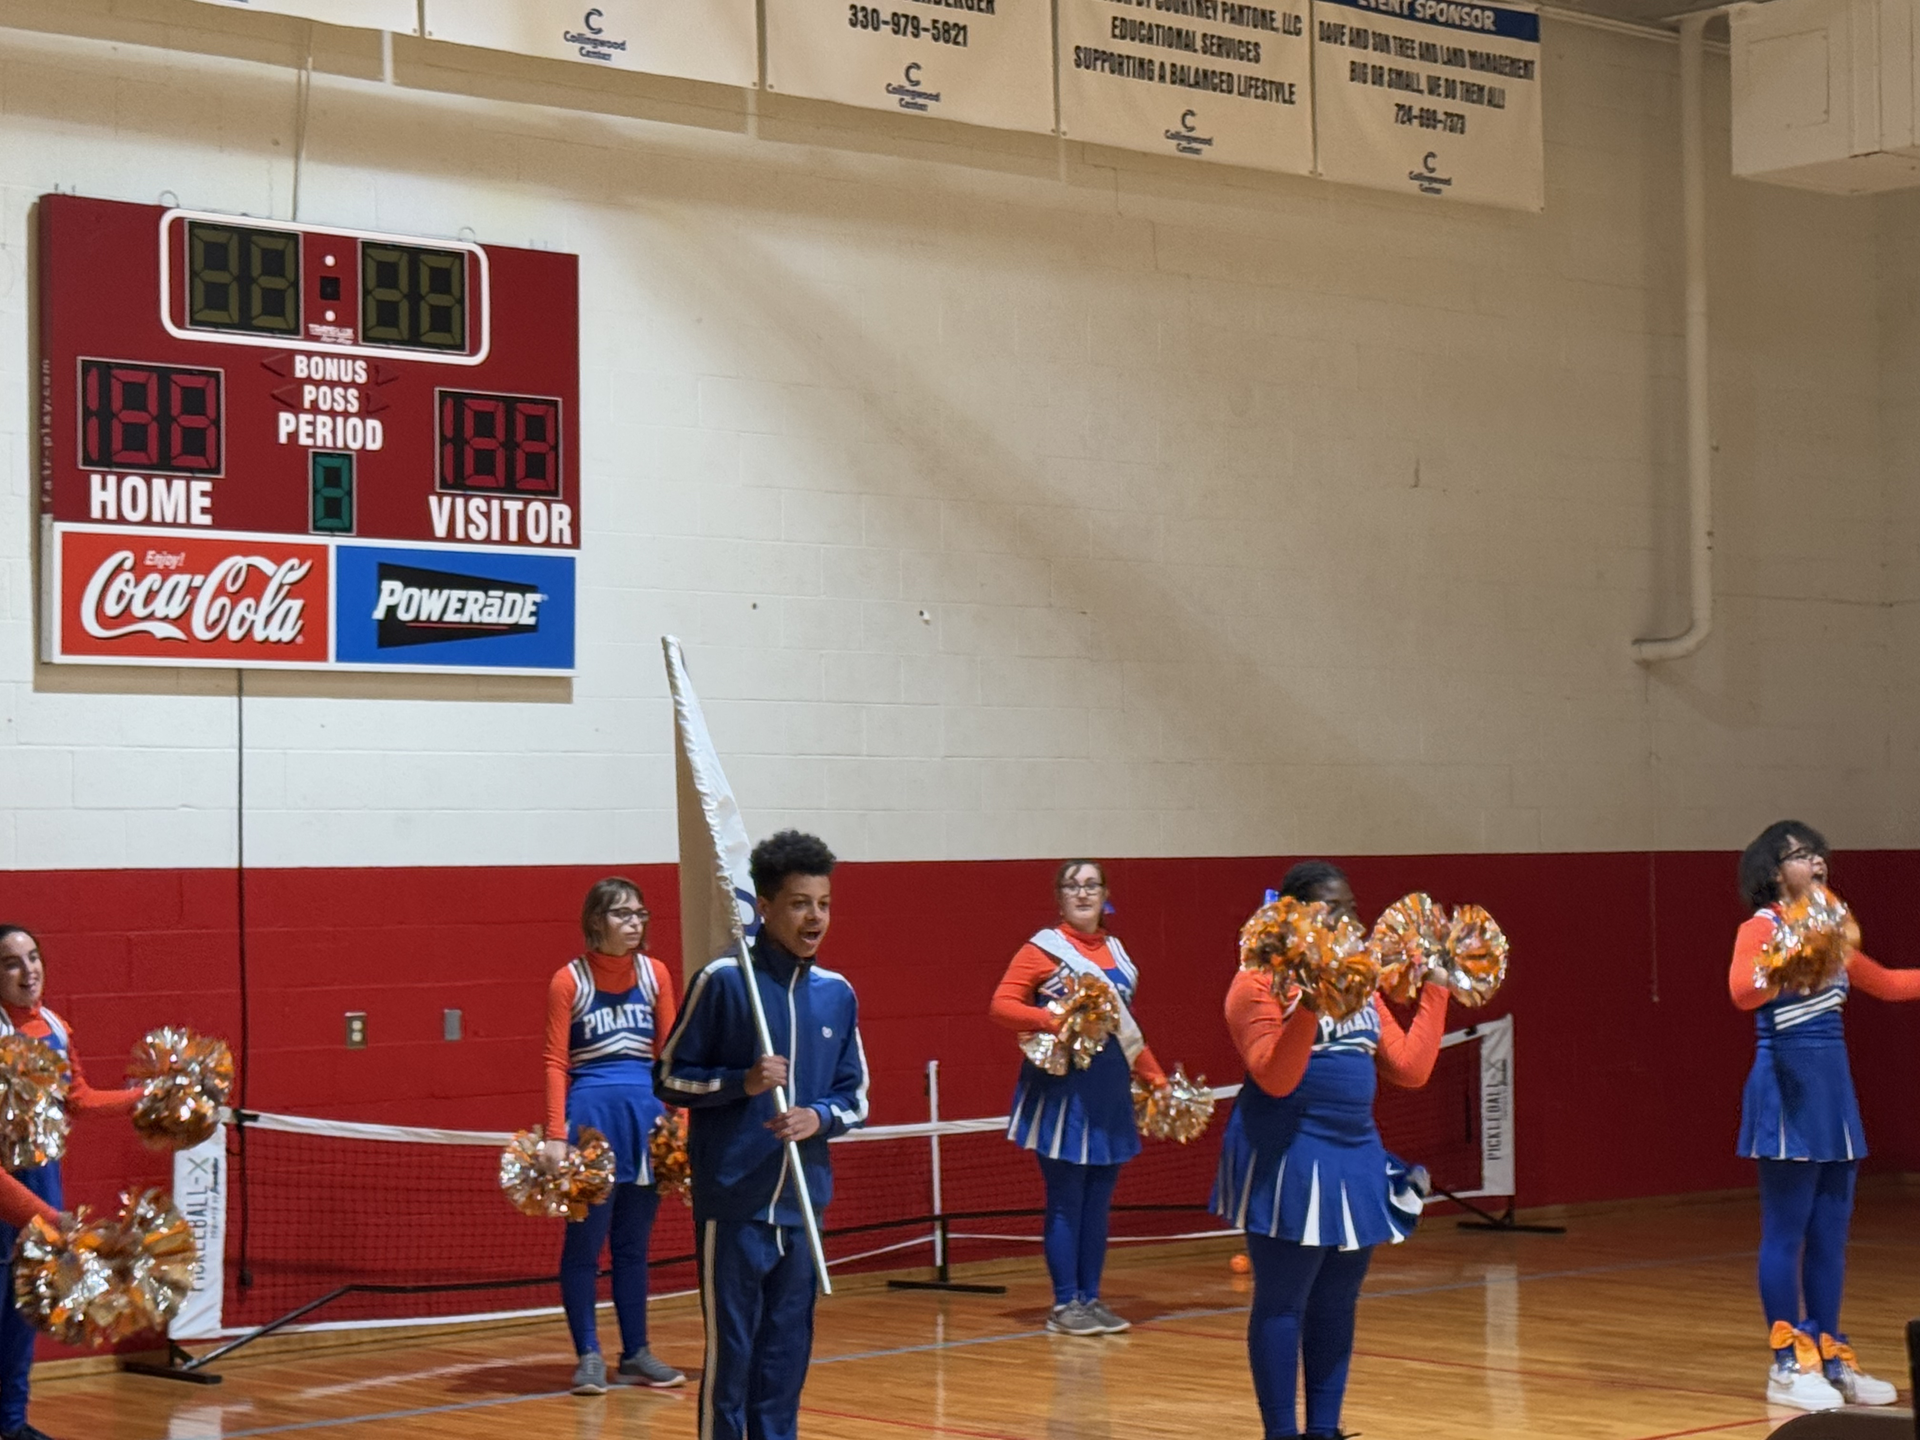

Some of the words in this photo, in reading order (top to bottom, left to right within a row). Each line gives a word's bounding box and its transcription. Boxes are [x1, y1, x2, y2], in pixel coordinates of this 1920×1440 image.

[849, 4, 968, 47] 330-979-5821
[1282, 12, 1303, 36] LLC
[1414, 1, 1496, 32] SPONSOR
[1111, 16, 1198, 53] EDUCATIONAL
[1201, 33, 1261, 64] SERVICES
[1074, 45, 1156, 82] SUPPORTING
[1158, 61, 1167, 84] A
[1170, 63, 1234, 95] BALANCED
[1237, 74, 1296, 105] LIFESTYLE
[294, 355, 368, 384] BONUS
[303, 384, 360, 414] POSS
[278, 411, 383, 451] PERIOD
[90, 474, 213, 525] HOME
[428, 495, 573, 545] VISITOR
[144, 550, 186, 570] Enjoy!
[80, 550, 313, 643] Coca-Cola
[582, 1003, 655, 1040] PIRATES
